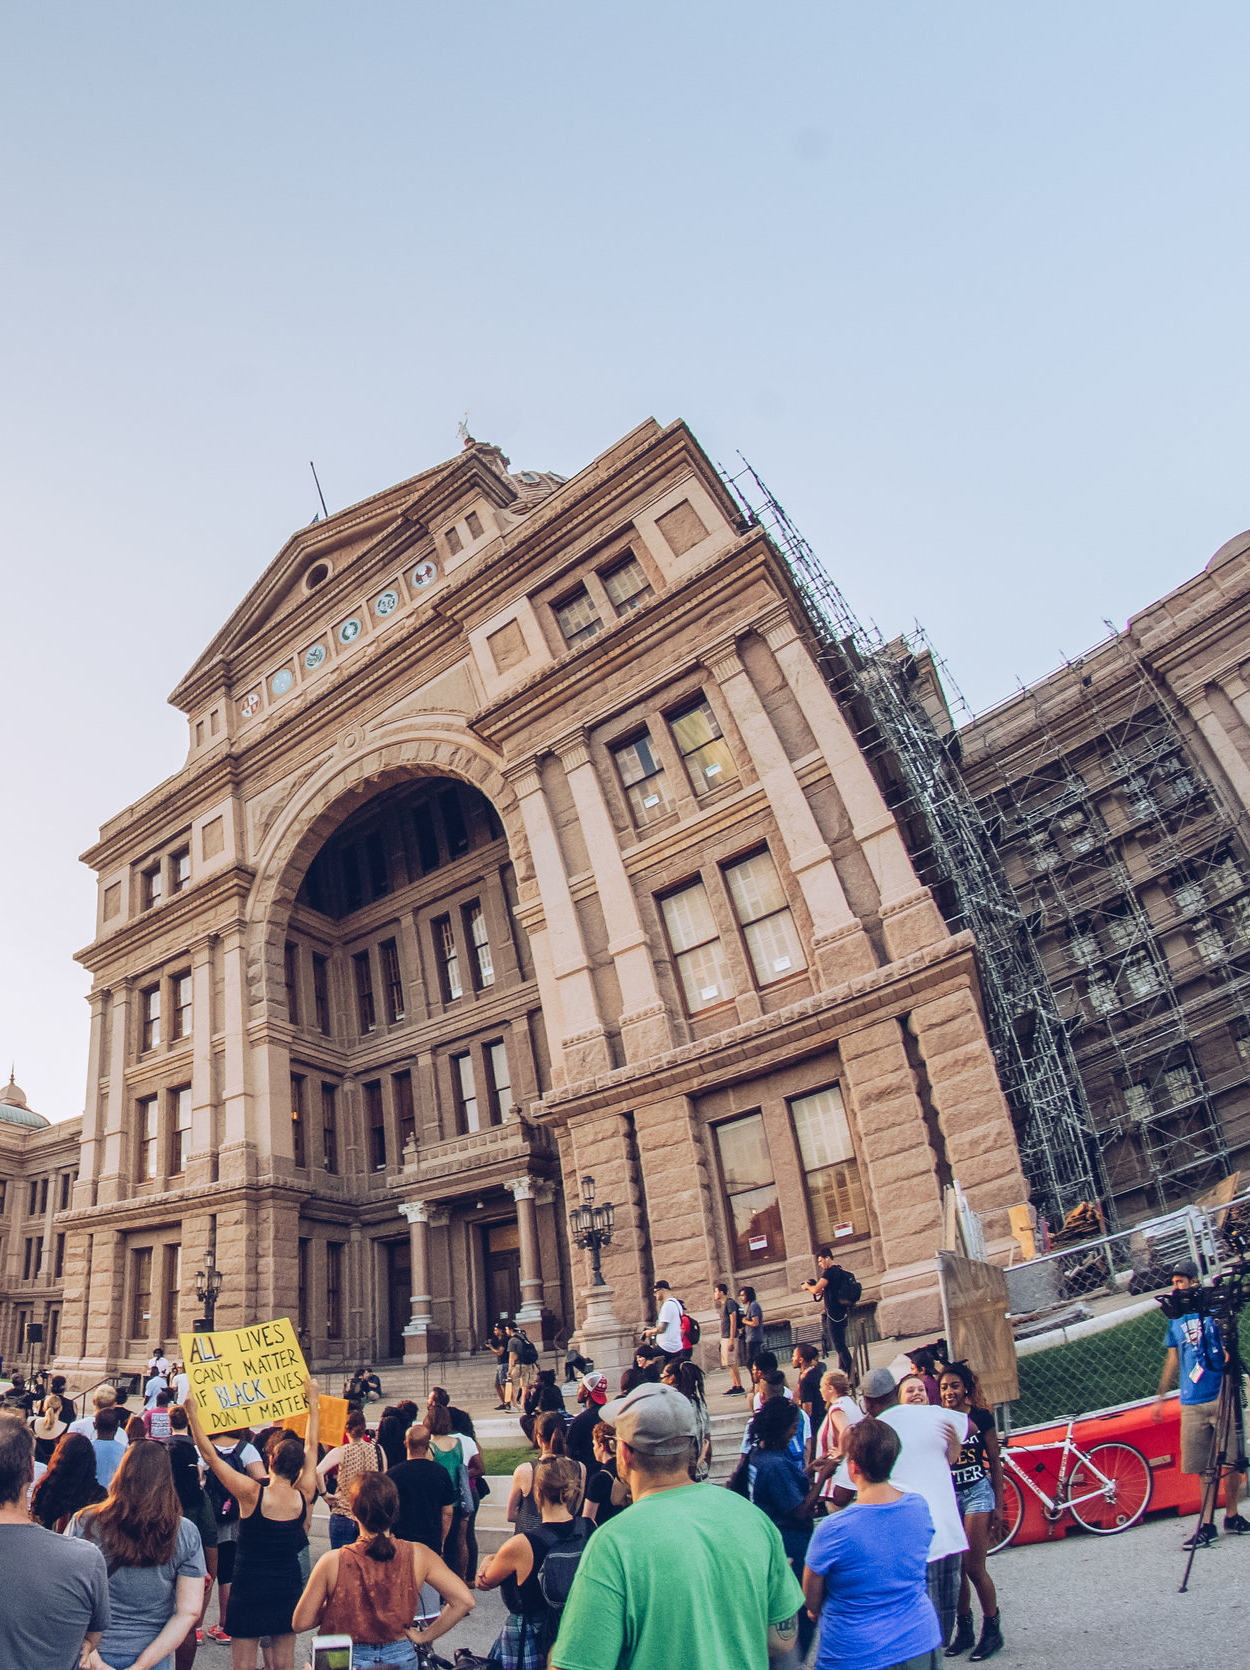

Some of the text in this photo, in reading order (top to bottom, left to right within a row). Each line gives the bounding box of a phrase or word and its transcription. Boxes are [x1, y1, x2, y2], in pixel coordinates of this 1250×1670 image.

[190, 1324, 285, 1363] ALL LIVES
[193, 1348, 299, 1385] CAN'T MATTER
[195, 1371, 304, 1410] IF BLACK LIVES
[259, 1392, 310, 1419] MATTER
[950, 1464, 983, 1485] TER
